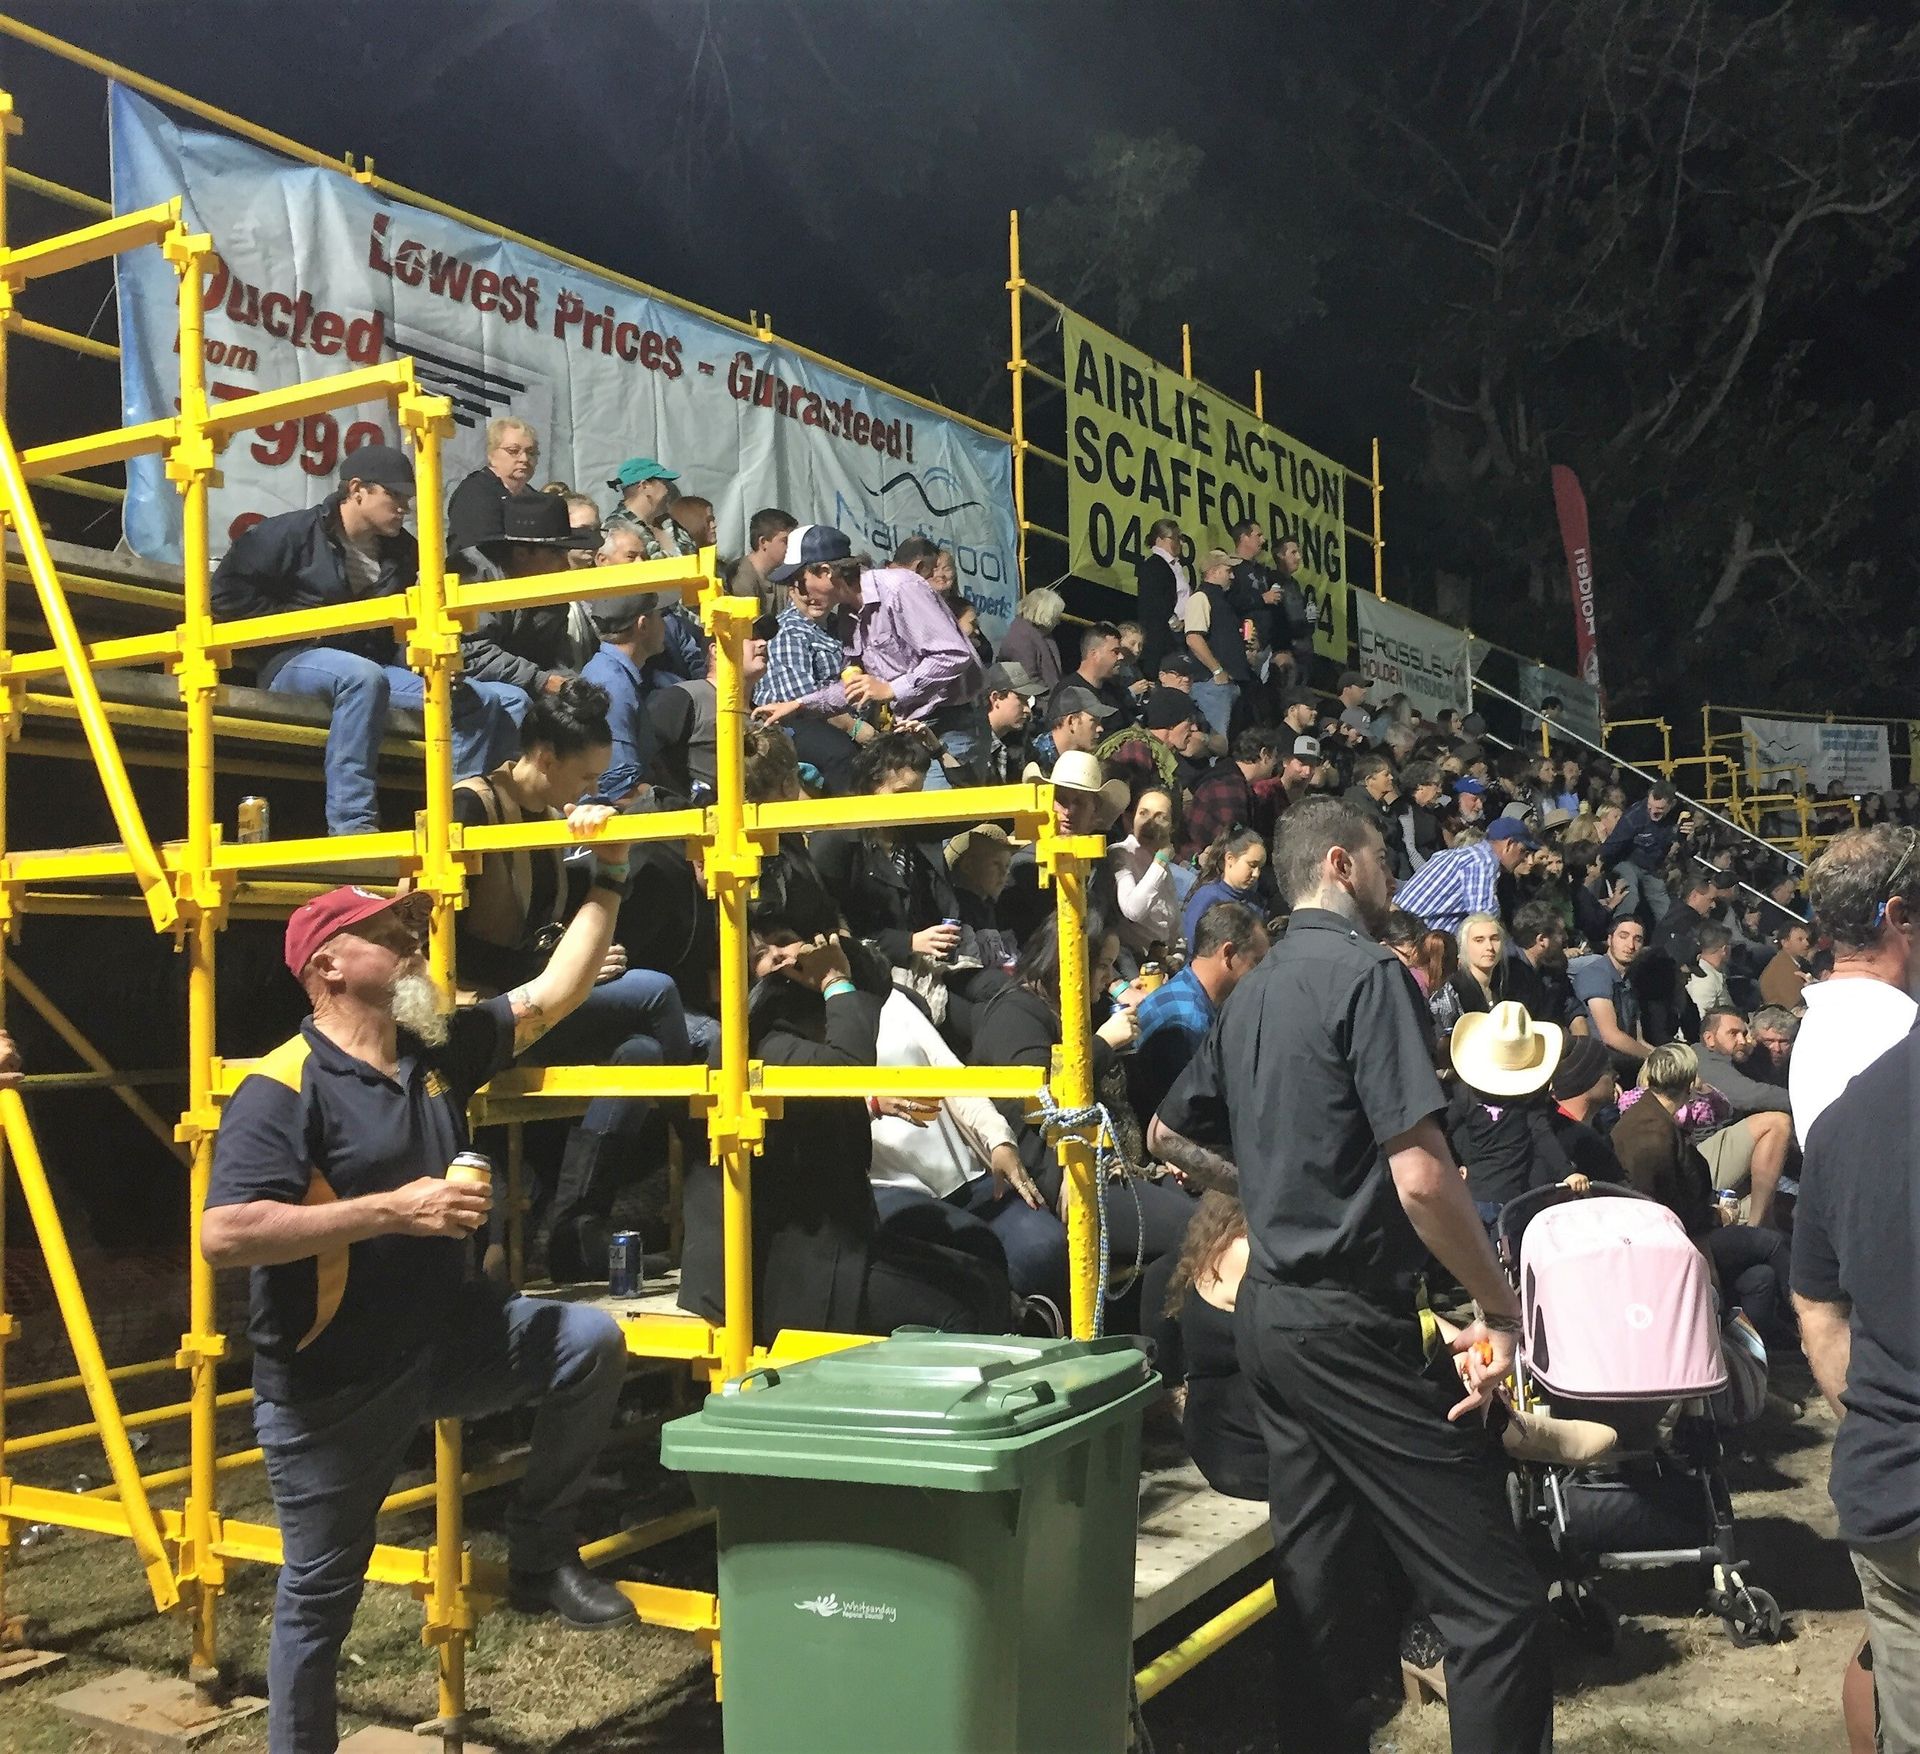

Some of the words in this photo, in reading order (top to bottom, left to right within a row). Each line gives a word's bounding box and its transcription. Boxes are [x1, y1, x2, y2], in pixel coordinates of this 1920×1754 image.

[369, 212, 538, 331] Lowest
[554, 287, 684, 379] Prices
[728, 351, 917, 465] Guaranteed!
[1074, 338, 1213, 458] AIRLIE
[1224, 418, 1341, 521] ACTION
[1074, 415, 1342, 584] SCAFFOLDING
[1360, 627, 1455, 681] CROSSLEY
